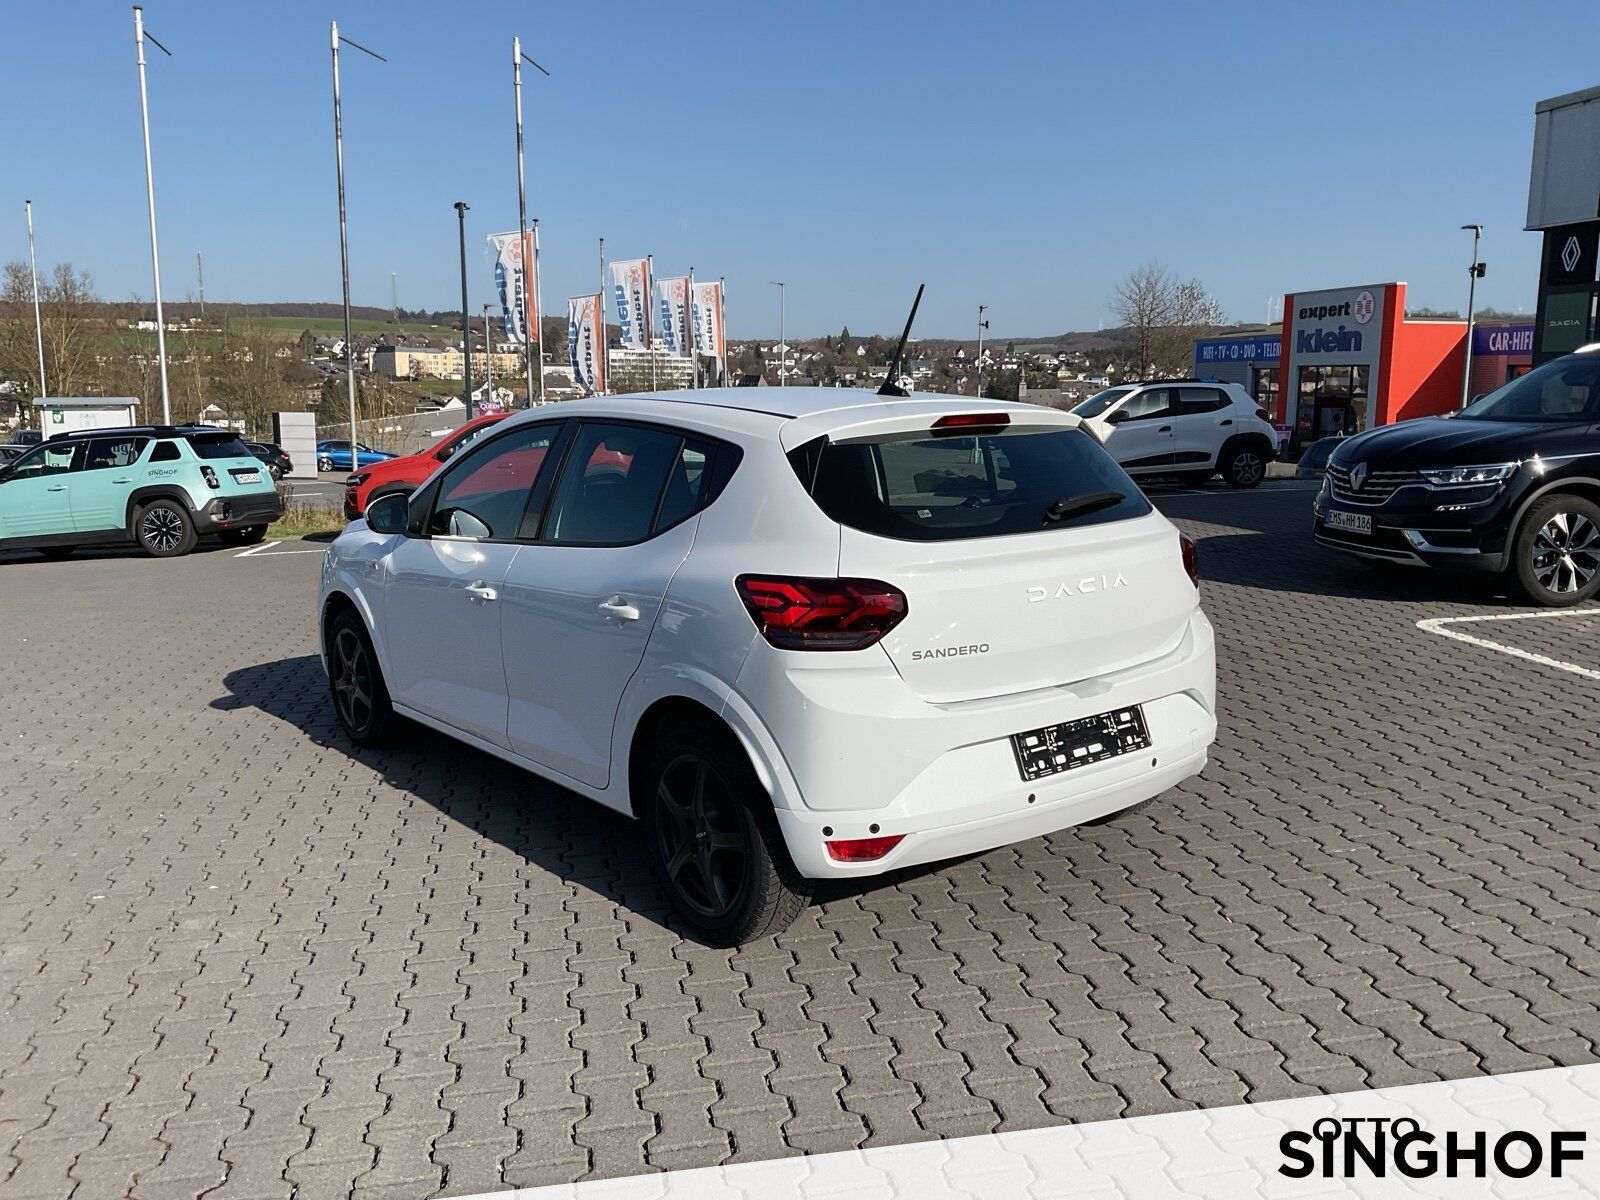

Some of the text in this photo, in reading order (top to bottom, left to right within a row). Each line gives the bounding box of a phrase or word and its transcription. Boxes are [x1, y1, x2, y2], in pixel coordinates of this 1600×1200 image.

[1299, 302, 1351, 321] expert
[1549, 319, 1580, 327] DACIA
[1296, 325, 1363, 353] klein
[1489, 331, 1534, 351] CAR-HIFI
[1203, 346, 1214, 360] HIFI
[1218, 345, 1227, 359] TV
[1231, 345, 1239, 358] CD
[1243, 344, 1256, 358] DVD
[148, 469, 178, 477] SINGHOF
[1330, 511, 1342, 525] EMS
[1357, 516, 1370, 530] 186
[1026, 572, 1129, 603] DACIA
[912, 643, 990, 661] SANDERO
